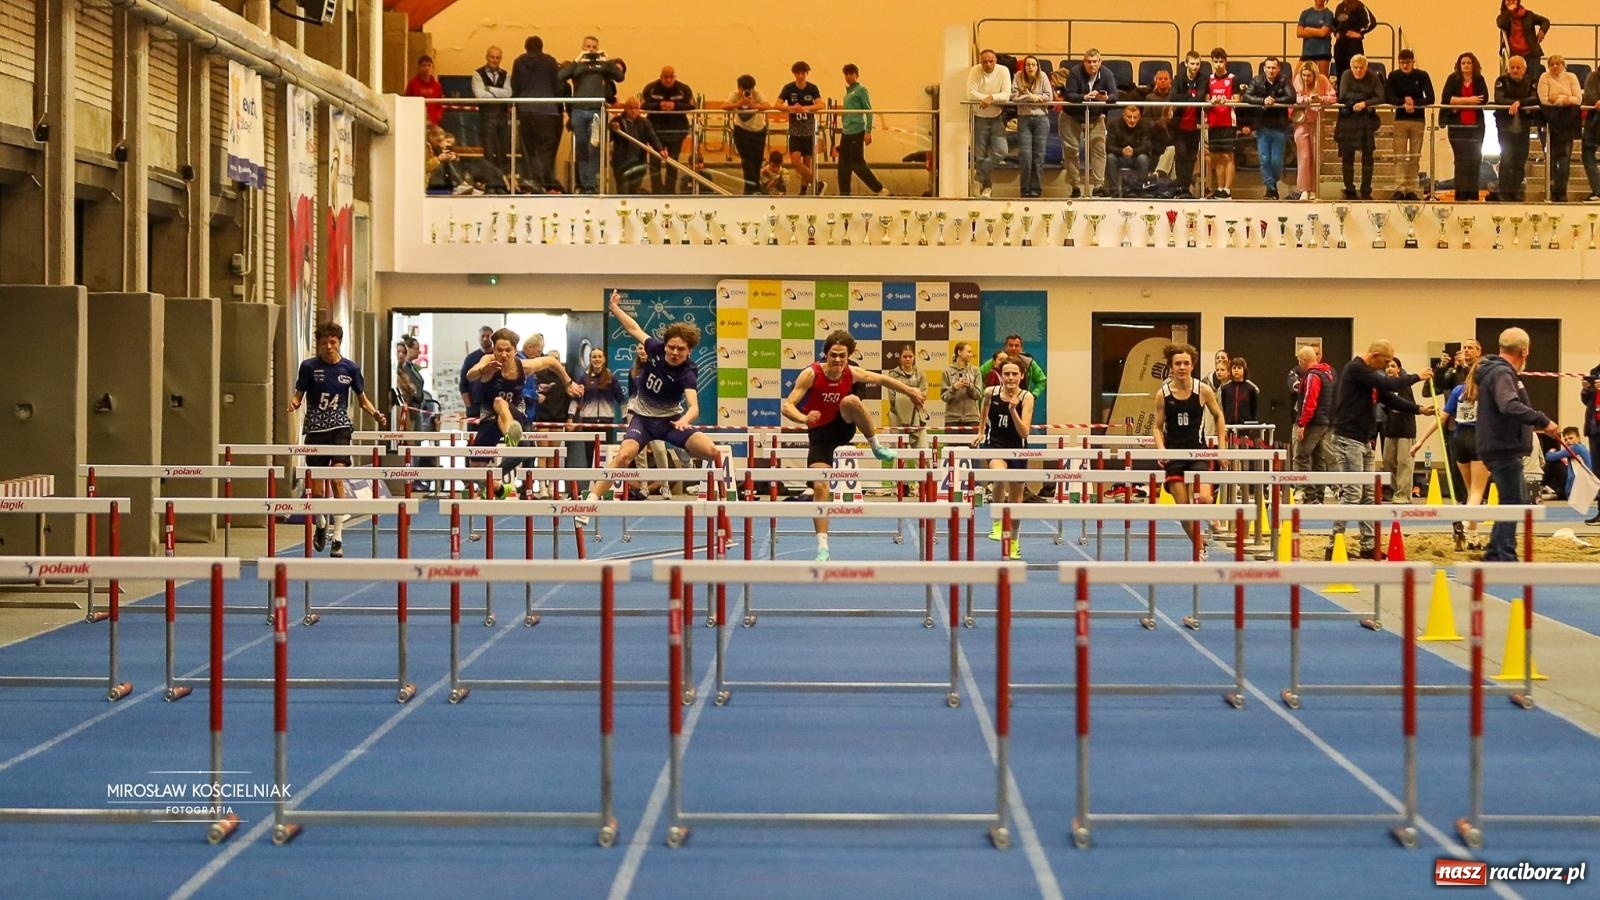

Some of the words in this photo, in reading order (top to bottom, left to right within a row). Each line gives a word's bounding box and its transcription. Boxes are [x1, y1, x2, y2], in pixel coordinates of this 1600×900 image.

[646, 373, 663, 393] 50
[318, 392, 339, 411] 54
[998, 414, 1008, 428] 74
[1177, 412, 1188, 426] 66
[173, 468, 203, 476] polanik
[390, 469, 420, 477] polanik
[610, 471, 640, 479] polanik
[829, 471, 859, 479] polanik
[561, 505, 599, 514] polanik
[827, 506, 864, 515] polanik
[1400, 510, 1438, 518] polanik
[39, 562, 91, 577] polanik
[428, 564, 480, 580] polanik
[823, 567, 875, 581] polanik
